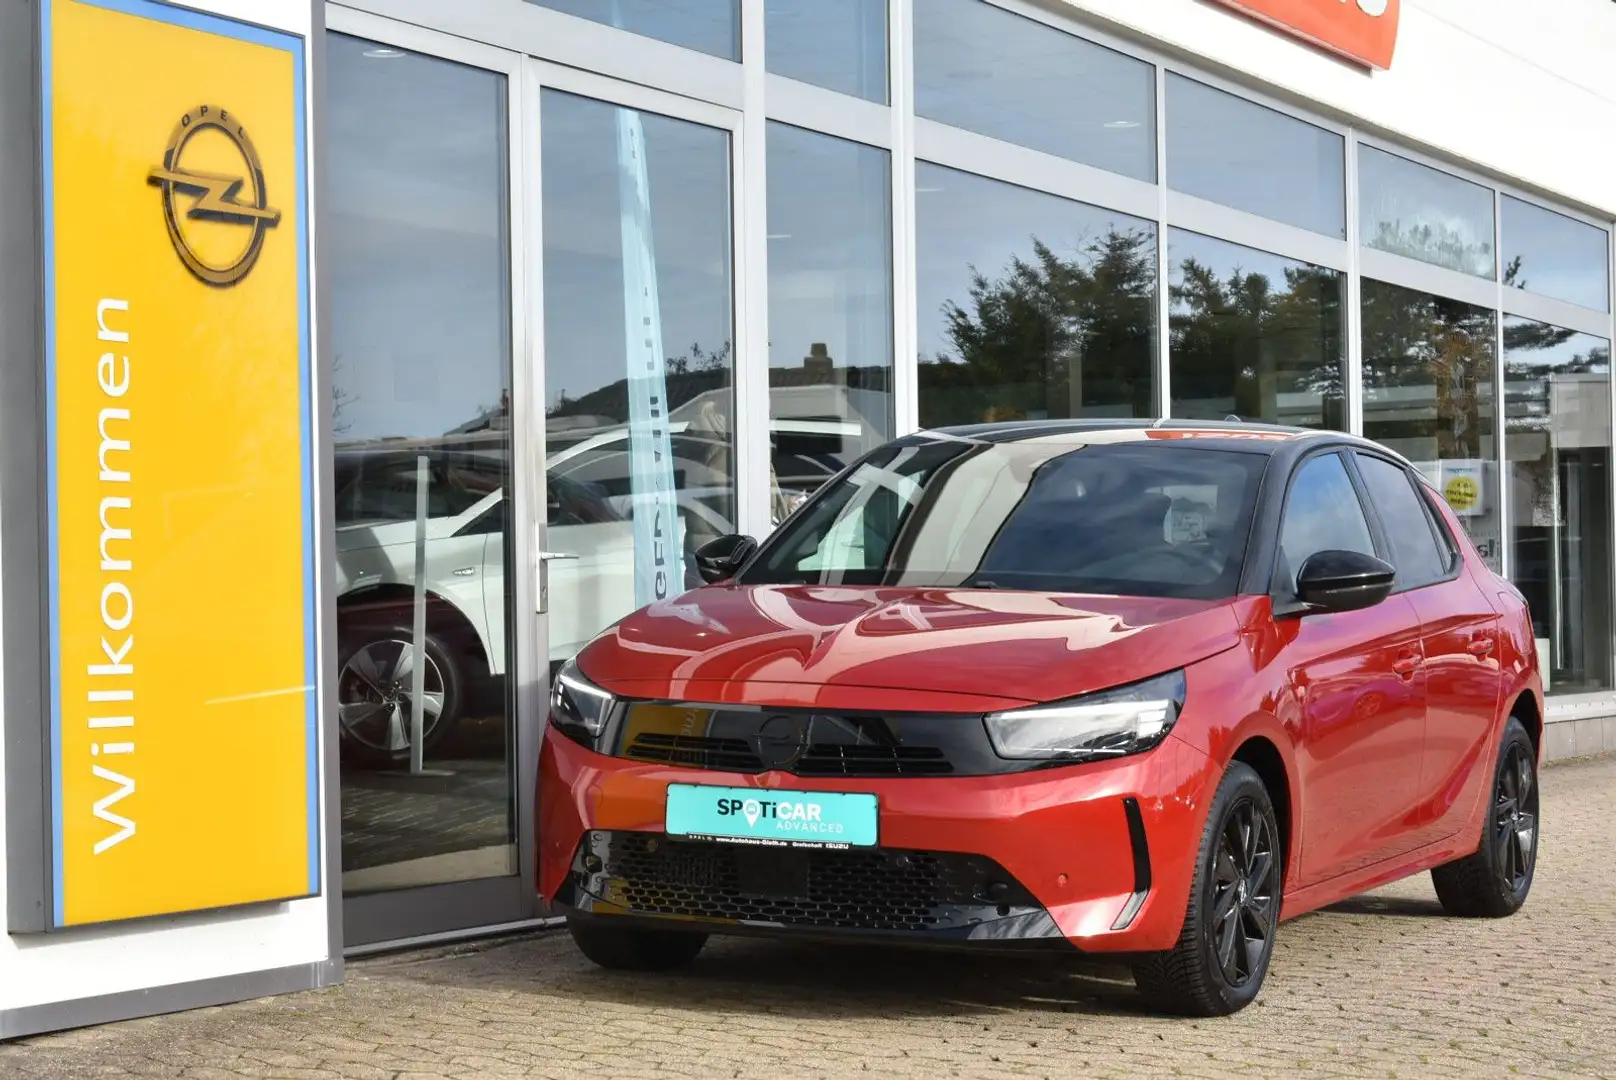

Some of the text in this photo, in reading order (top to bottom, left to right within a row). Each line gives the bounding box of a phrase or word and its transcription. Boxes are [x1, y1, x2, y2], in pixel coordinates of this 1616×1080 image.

[181, 105, 244, 139] OPEL
[88, 298, 136, 856] Willkommen
[776, 820, 844, 834] ADVANCED
